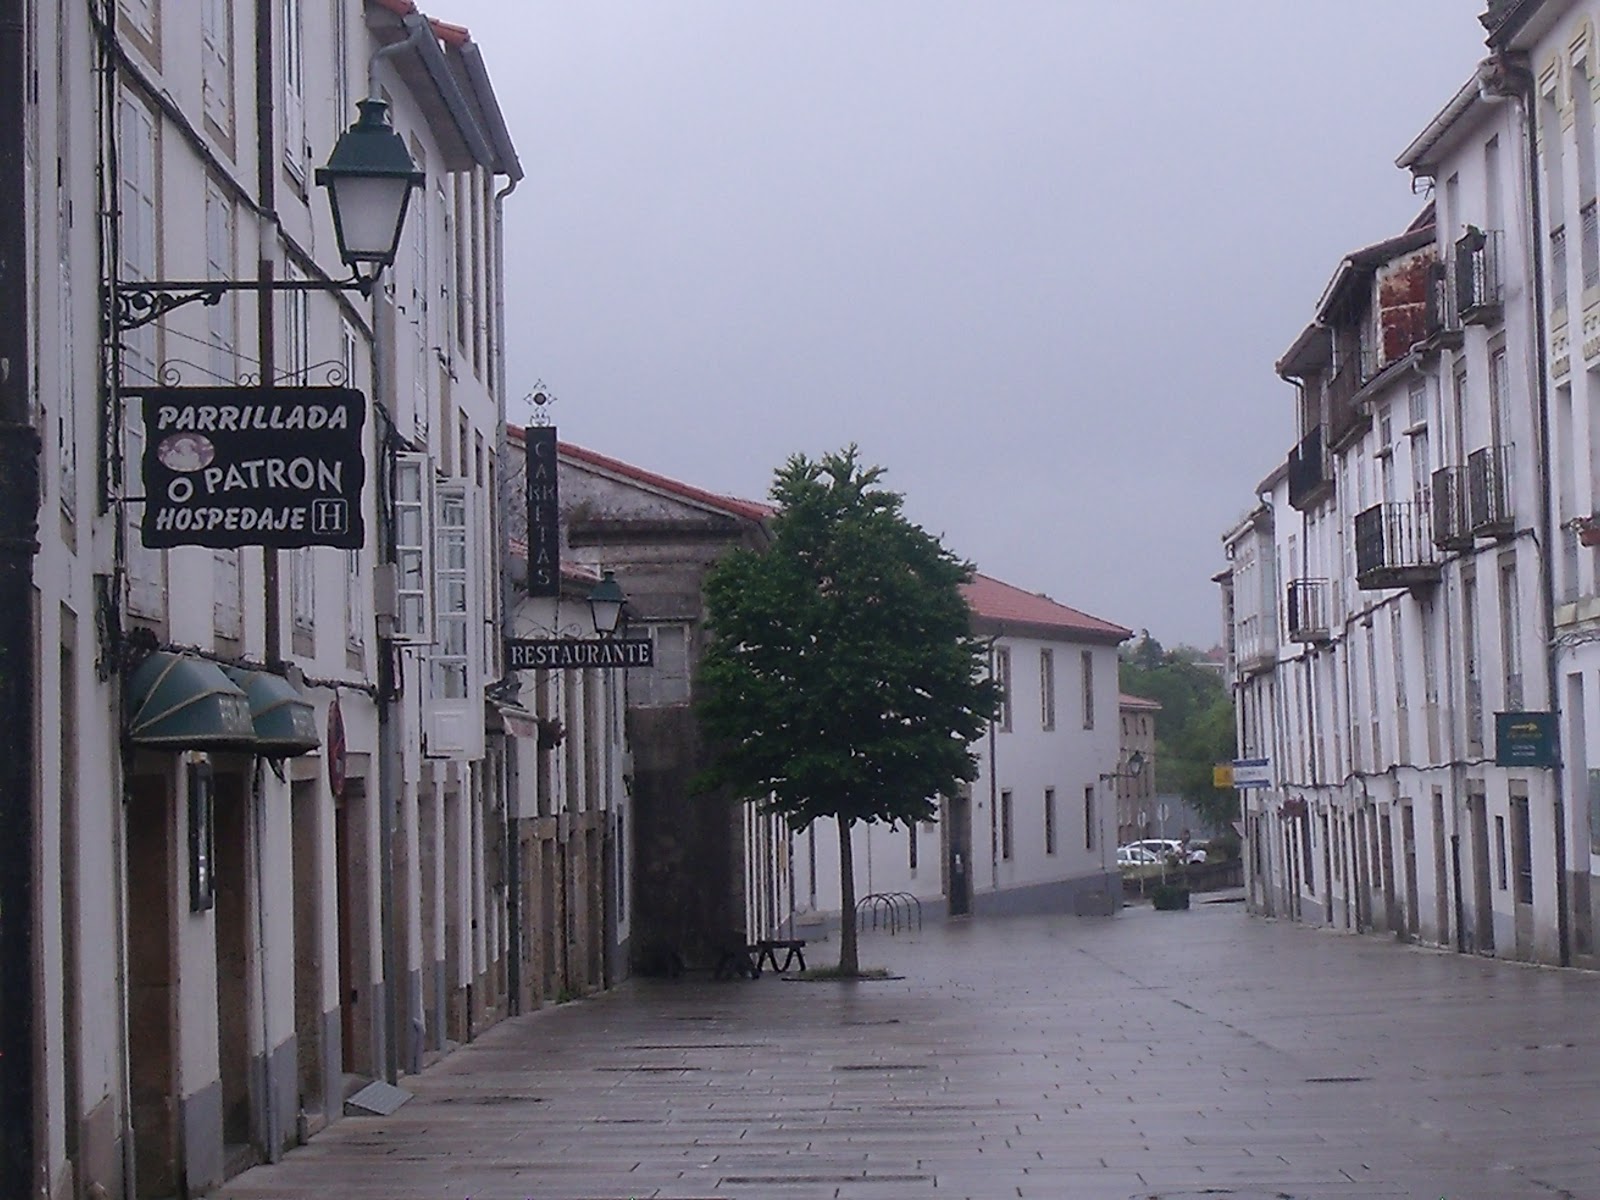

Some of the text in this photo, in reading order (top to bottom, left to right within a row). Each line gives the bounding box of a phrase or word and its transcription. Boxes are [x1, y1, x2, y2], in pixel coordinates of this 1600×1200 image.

[157, 405, 348, 431] PARRILLADA
[167, 456, 343, 503] O PATRON
[156, 501, 343, 532] HOSPEDAJE H
[511, 643, 649, 665] RESTAURANTE
